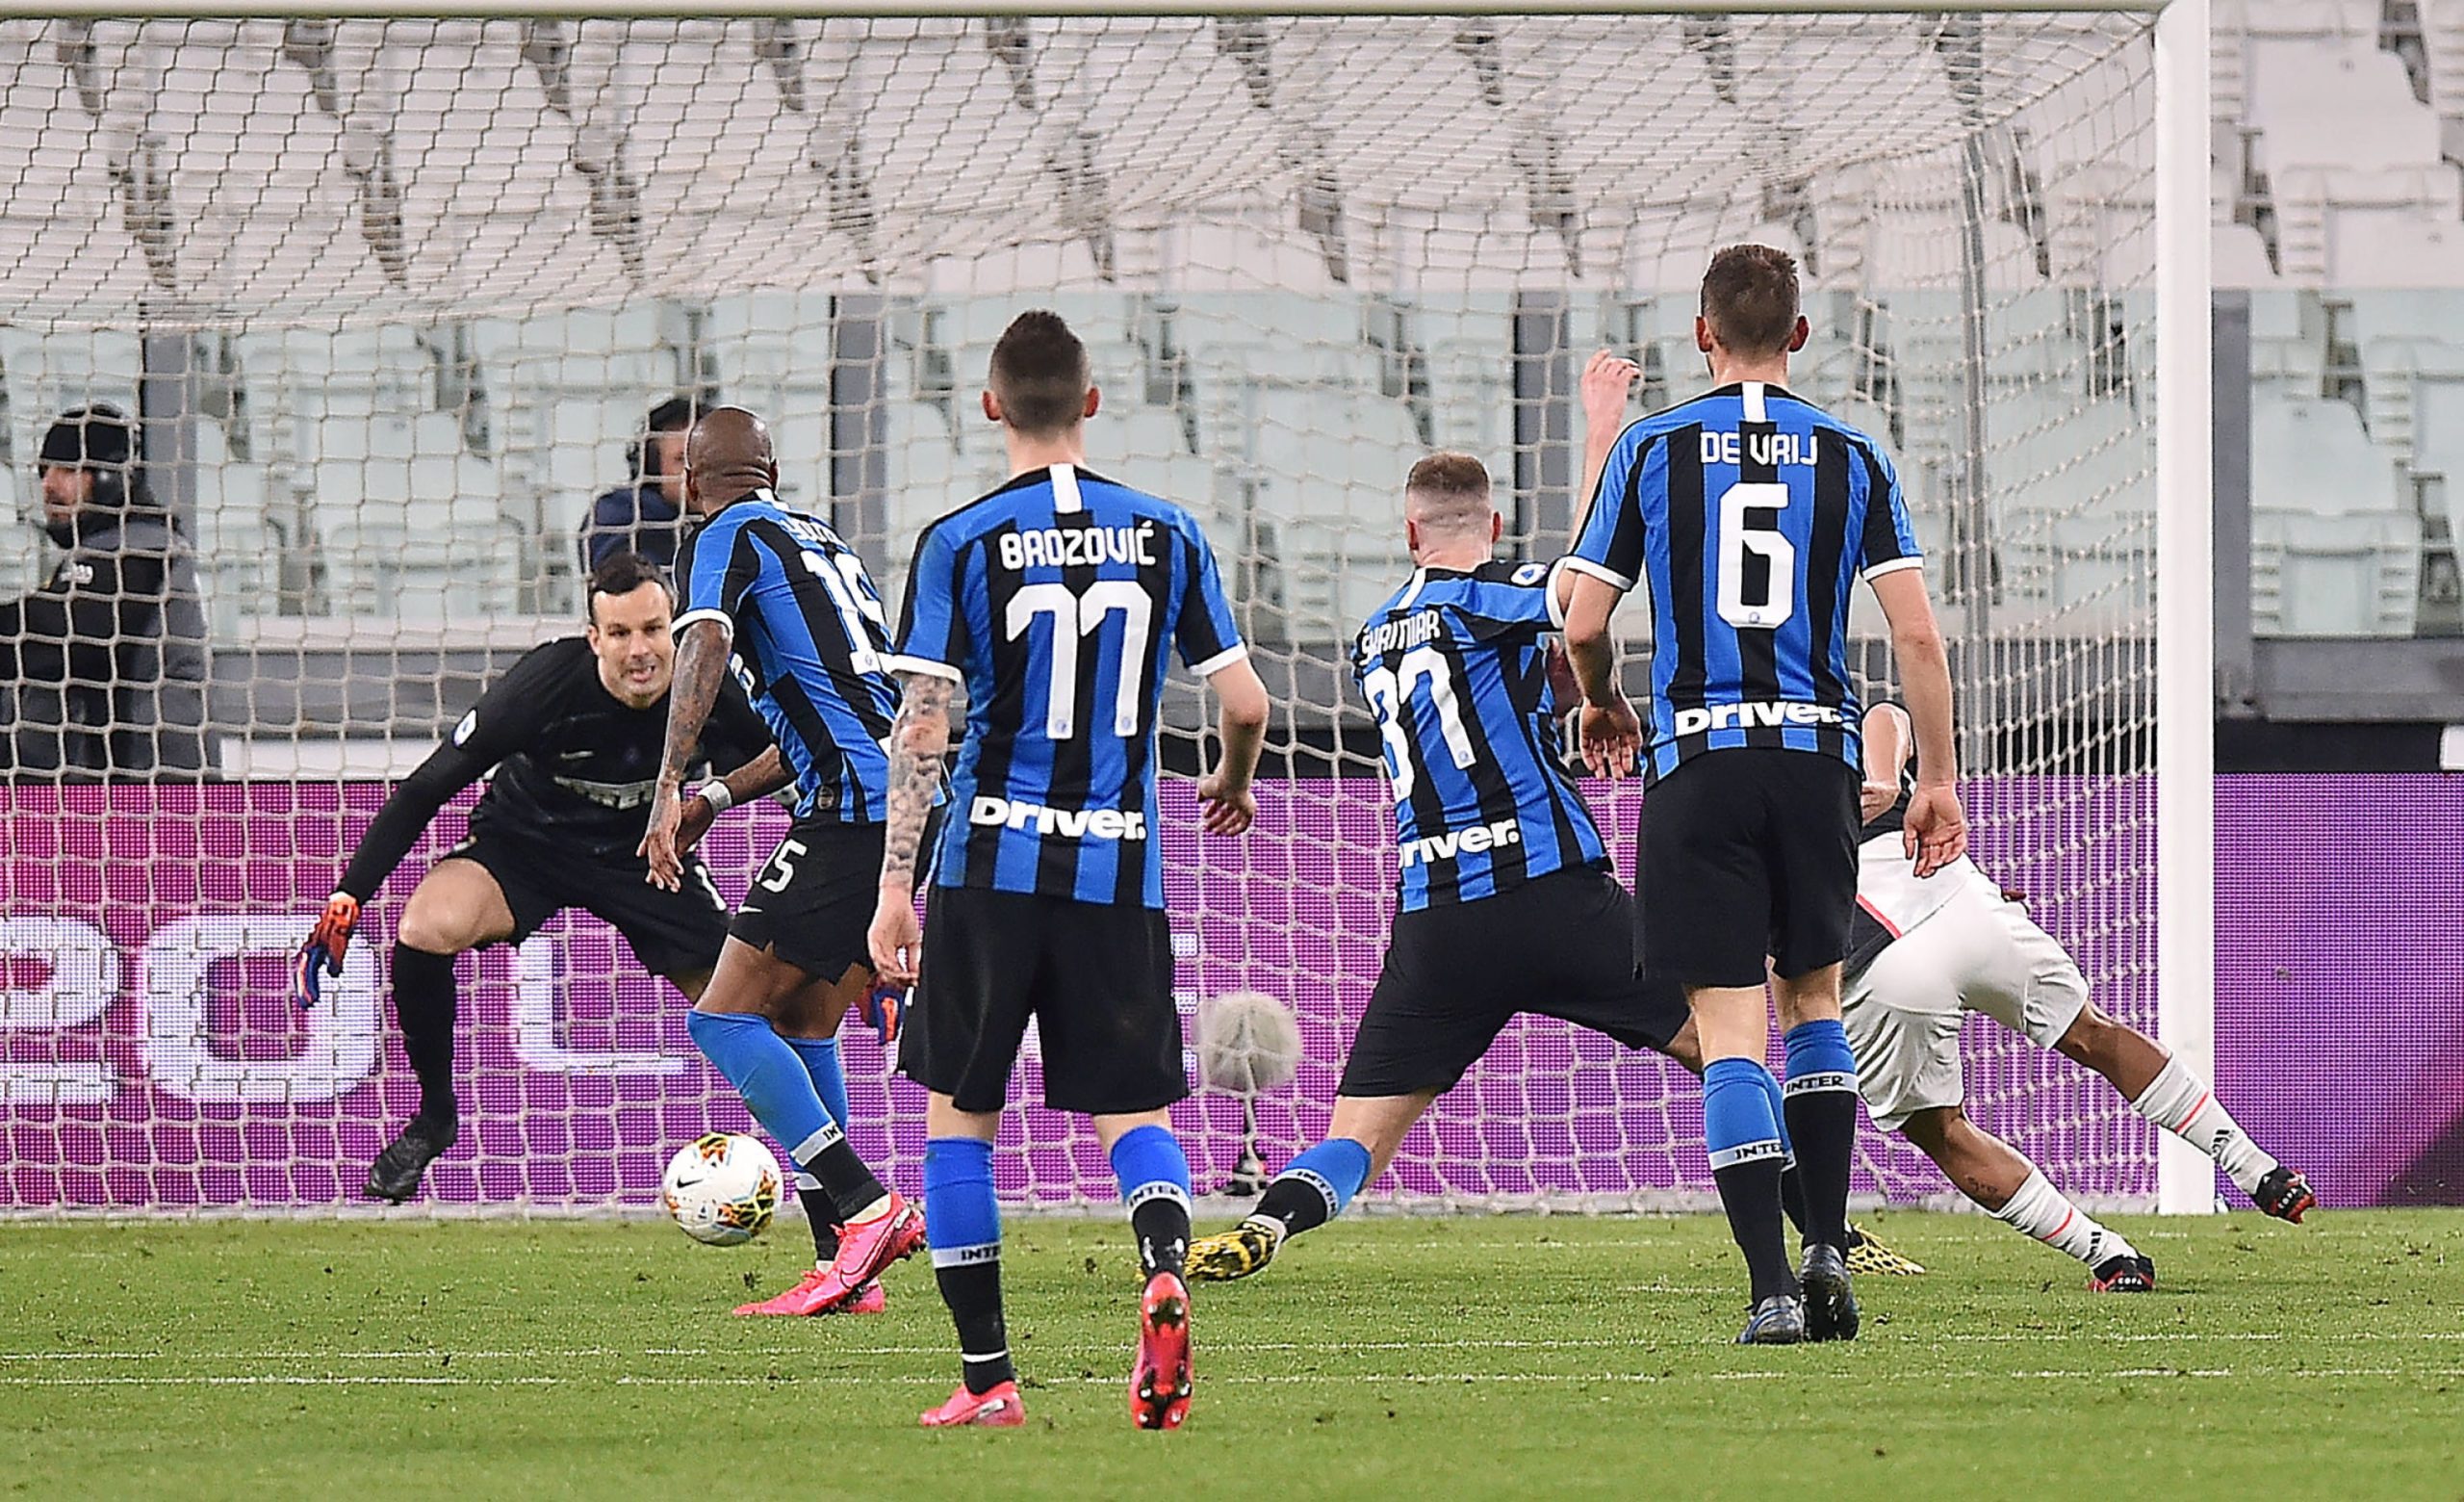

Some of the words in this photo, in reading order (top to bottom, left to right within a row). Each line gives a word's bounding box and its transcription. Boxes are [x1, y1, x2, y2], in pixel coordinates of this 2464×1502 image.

[1700, 431, 1741, 464] DE
[1749, 433, 1819, 466] VRIJ
[999, 519, 1156, 570] BROZOVIĆ
[1716, 481, 1796, 630] 6
[1005, 580, 1153, 740] 77
[1362, 644, 1477, 807] 37
[1398, 817, 1520, 869] river.
[1785, 1075, 1845, 1095] INTER
[1735, 1142, 1782, 1160] INTE
[961, 1245, 1000, 1261] INTE
